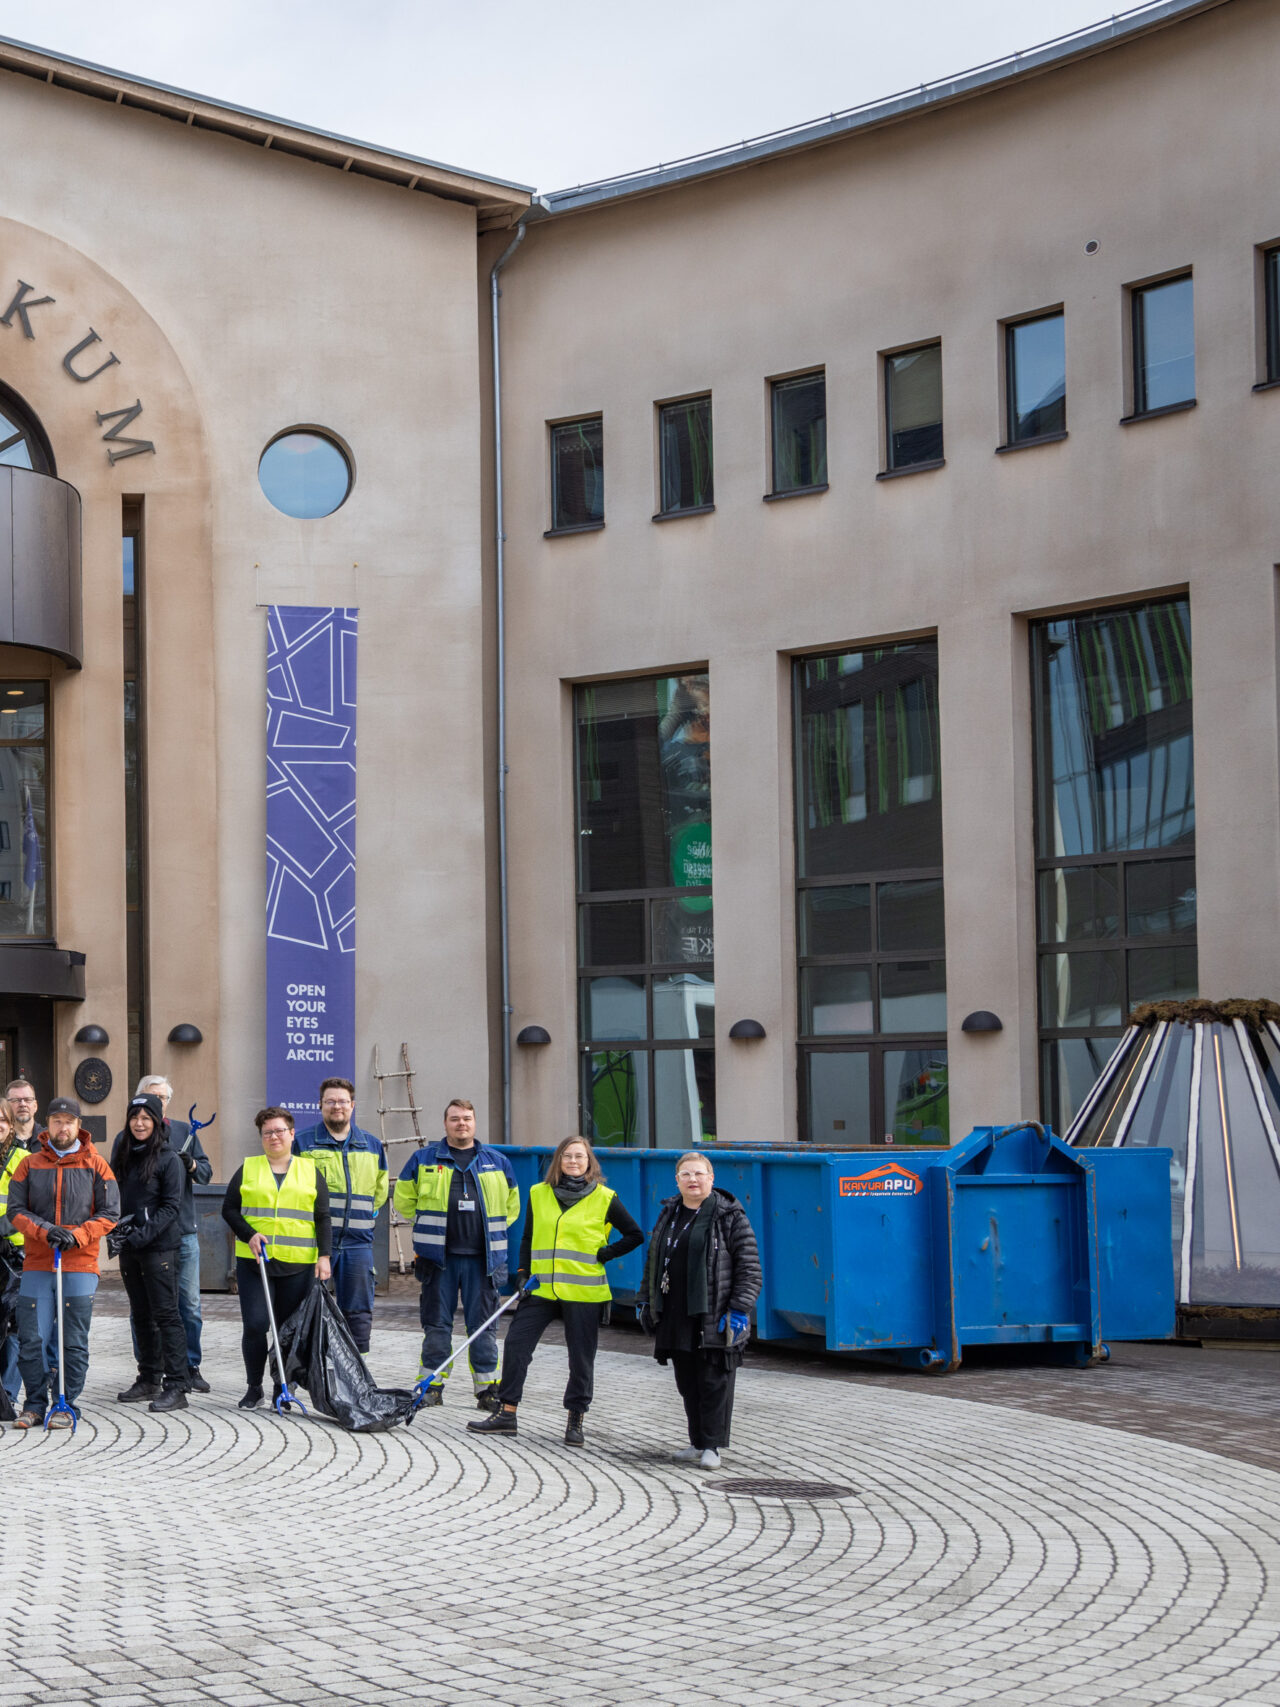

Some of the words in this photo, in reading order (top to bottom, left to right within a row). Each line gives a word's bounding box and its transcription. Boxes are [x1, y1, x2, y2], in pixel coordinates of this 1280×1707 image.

[286, 983, 326, 997] OPEN
[286, 1000, 326, 1013] YOUR
[286, 1016, 319, 1029] EYES
[286, 1032, 305, 1045] TO
[309, 1033, 334, 1046] THE
[286, 1049, 334, 1062] ARCTIC
